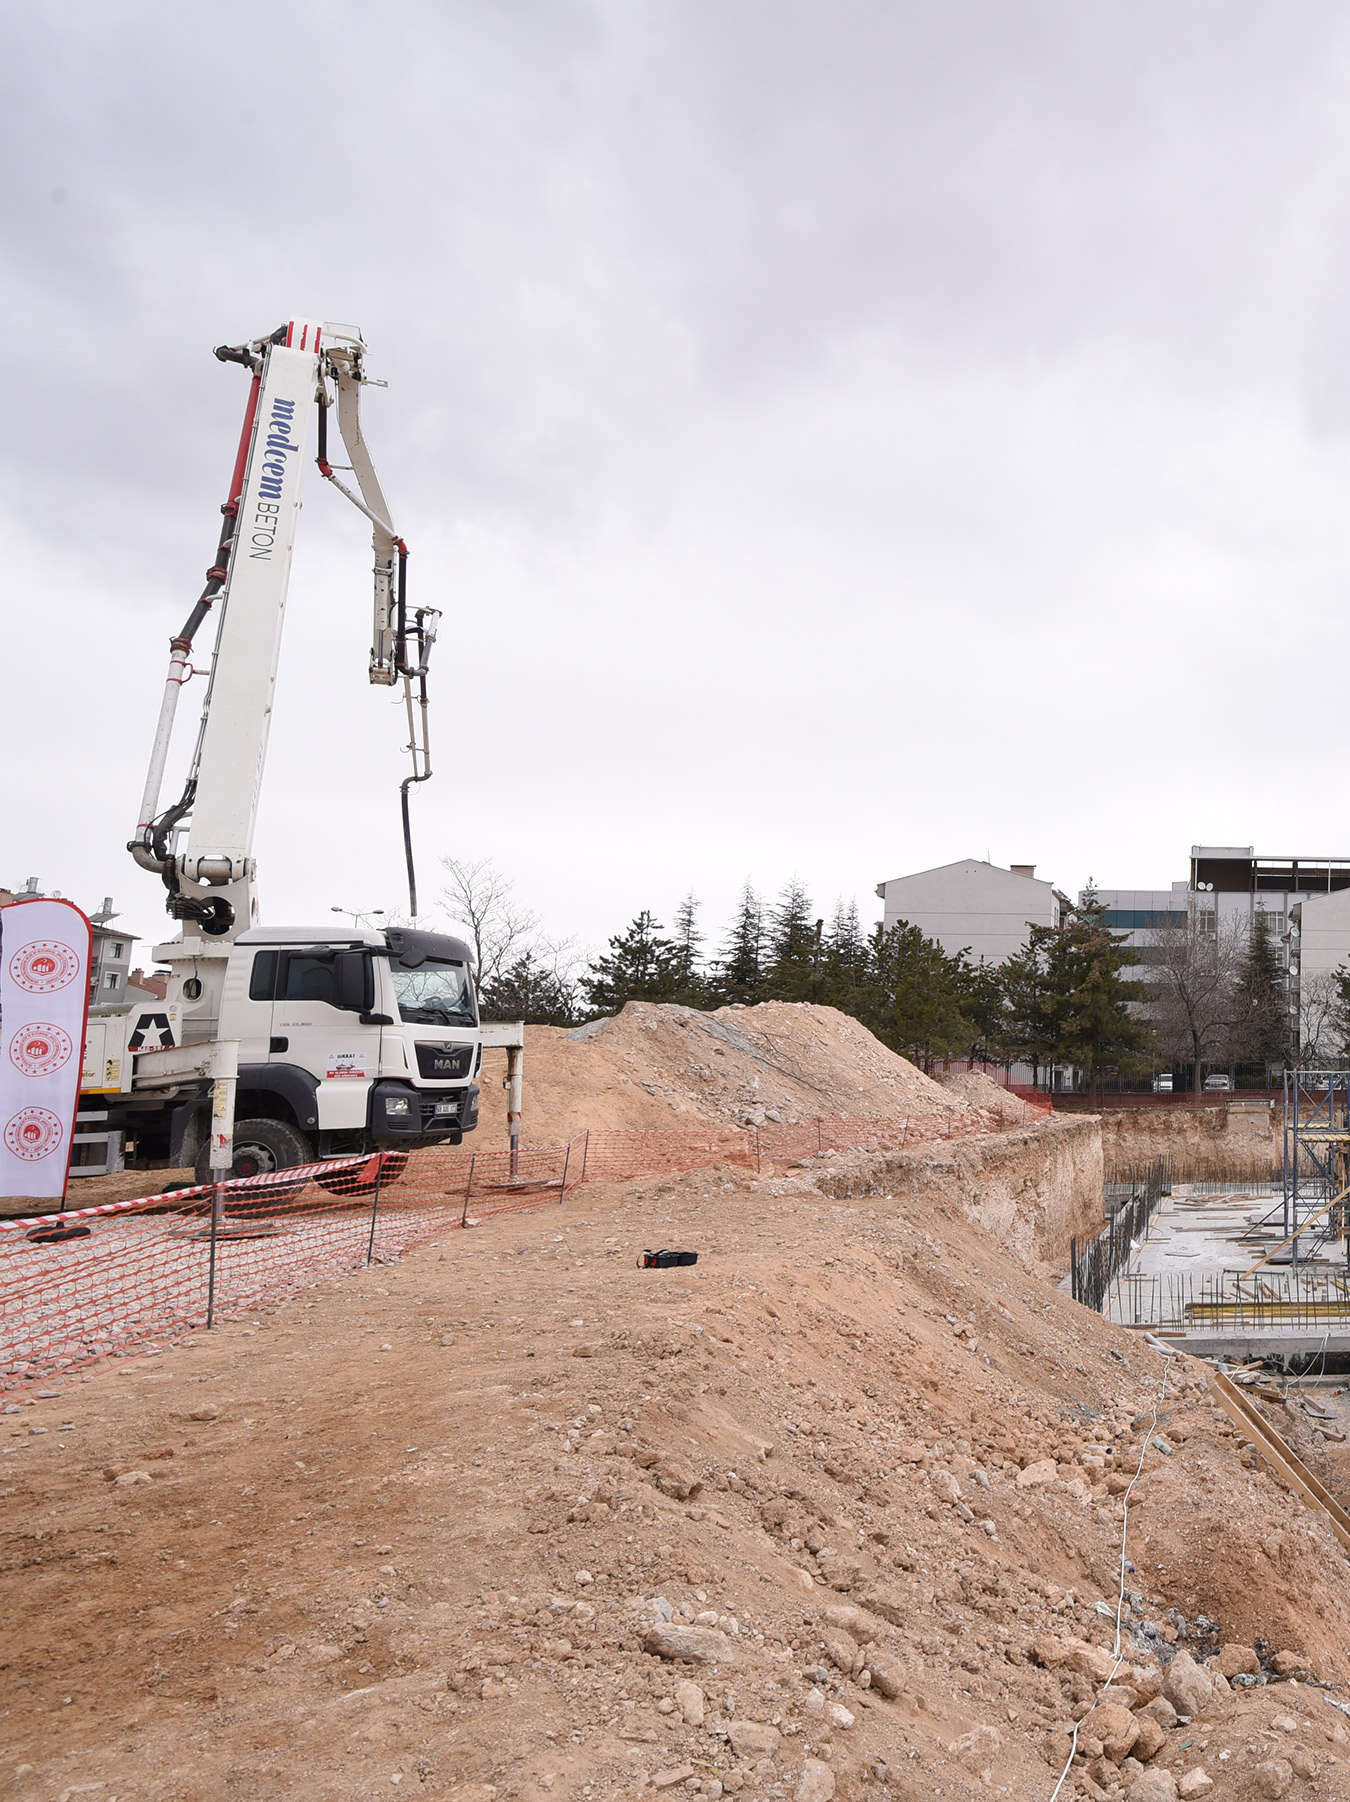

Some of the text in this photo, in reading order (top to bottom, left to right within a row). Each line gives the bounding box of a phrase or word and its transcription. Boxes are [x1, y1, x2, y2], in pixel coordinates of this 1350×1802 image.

[249, 397, 299, 561] medcem BETON
[434, 1059, 460, 1069] MAN
